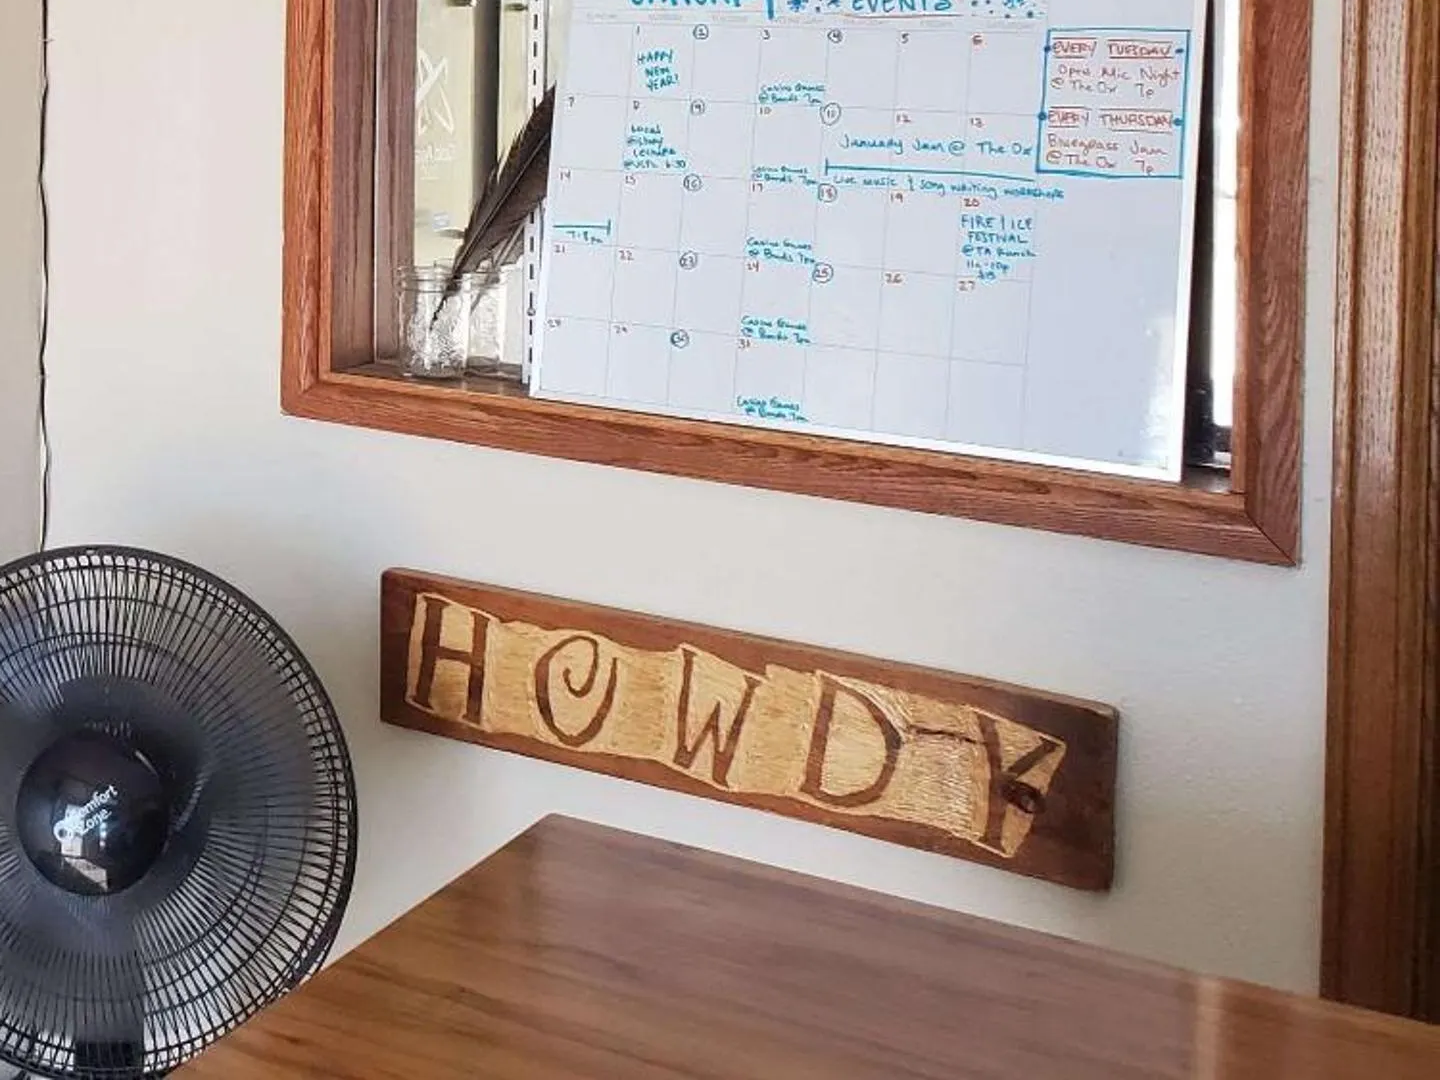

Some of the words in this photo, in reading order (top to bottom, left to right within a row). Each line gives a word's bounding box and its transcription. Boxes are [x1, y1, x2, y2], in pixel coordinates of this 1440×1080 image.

[636, 25, 641, 34] 1
[763, 30, 771, 40] 3
[900, 33, 909, 43] 5
[972, 35, 983, 45] 6
[1053, 41, 1097, 57] EVERY
[1108, 42, 1172, 57] TUESDAY
[637, 49, 674, 64] HAPPY
[645, 67, 670, 77] NEW
[1060, 65, 1092, 80] Open
[1102, 66, 1131, 80] Mic
[1140, 68, 1181, 87] Night
[646, 74, 679, 92] YEAR!
[1070, 80, 1093, 92] The
[1097, 82, 1118, 94] Ox
[568, 96, 575, 107] 7
[759, 107, 772, 115] 10
[896, 114, 911, 123] 12
[1048, 110, 1090, 127] EVERY
[1099, 112, 1173, 129] THURSDAY
[839, 134, 903, 155] January
[912, 140, 943, 154] Jam
[948, 140, 965, 155] @
[977, 142, 1005, 155] The
[1013, 143, 1033, 156] Ox
[1129, 139, 1168, 156] Jam
[1066, 155, 1091, 166] The
[1096, 157, 1118, 169] Ox
[560, 171, 571, 181] 14
[625, 175, 636, 186] 15
[752, 182, 763, 193] 17
[920, 179, 946, 196] song
[890, 193, 903, 203] 19
[963, 197, 980, 207] 20
[961, 215, 996, 229] FIRE
[1011, 218, 1033, 230] ICE
[968, 232, 1029, 244] FESTIVAL
[554, 246, 565, 254] 21
[619, 250, 634, 261] 22
[748, 261, 759, 272] 24
[884, 273, 902, 283] 26
[959, 281, 975, 291] 27
[738, 339, 751, 350] 31
[414, 595, 1060, 848] HOWDY
